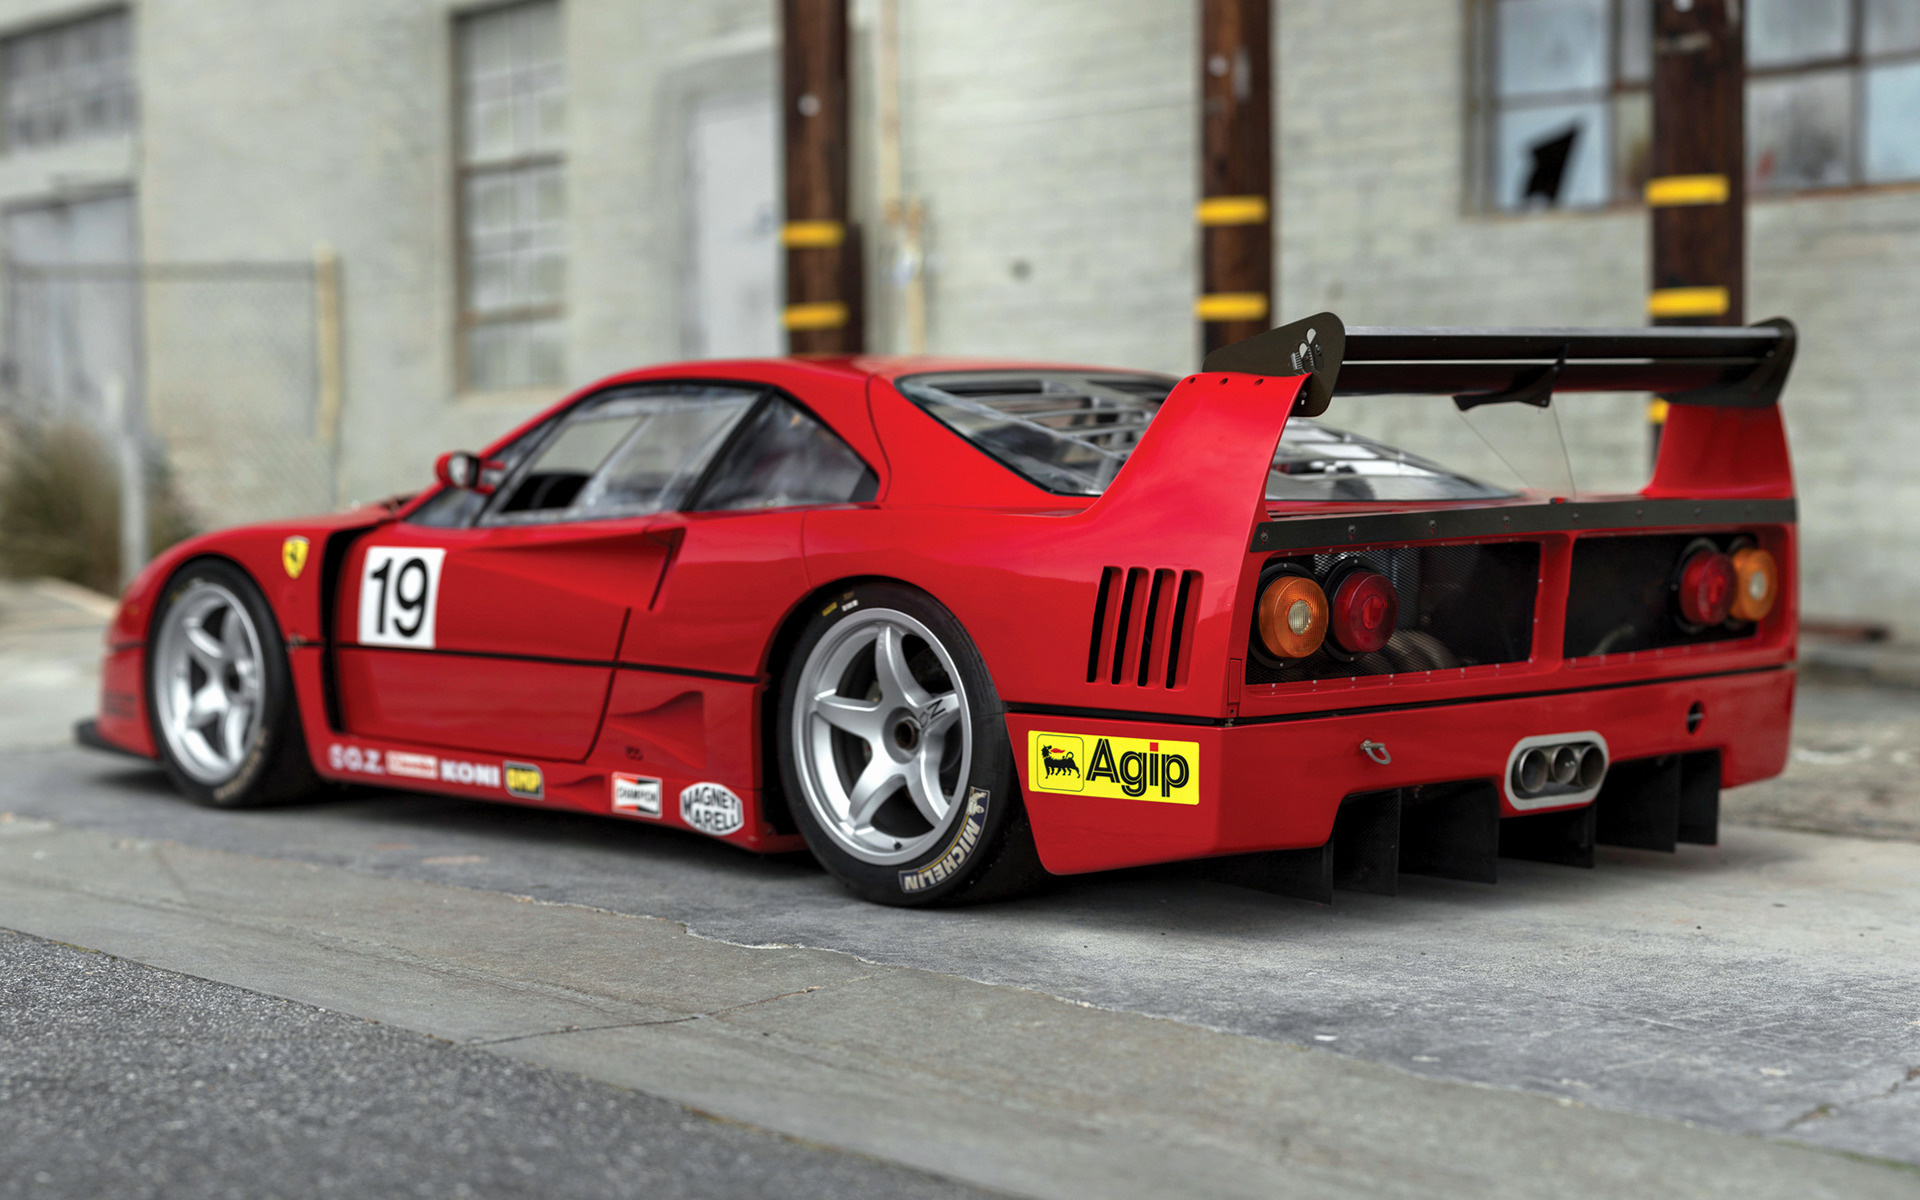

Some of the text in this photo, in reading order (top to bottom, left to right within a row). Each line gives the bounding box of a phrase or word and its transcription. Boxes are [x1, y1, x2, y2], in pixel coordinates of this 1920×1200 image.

[371, 557, 429, 638] 19
[440, 759, 500, 787] KONI
[617, 787, 659, 803] CHAMPION
[1085, 738, 1190, 798] Agip
[904, 817, 981, 891] MICHELIN
